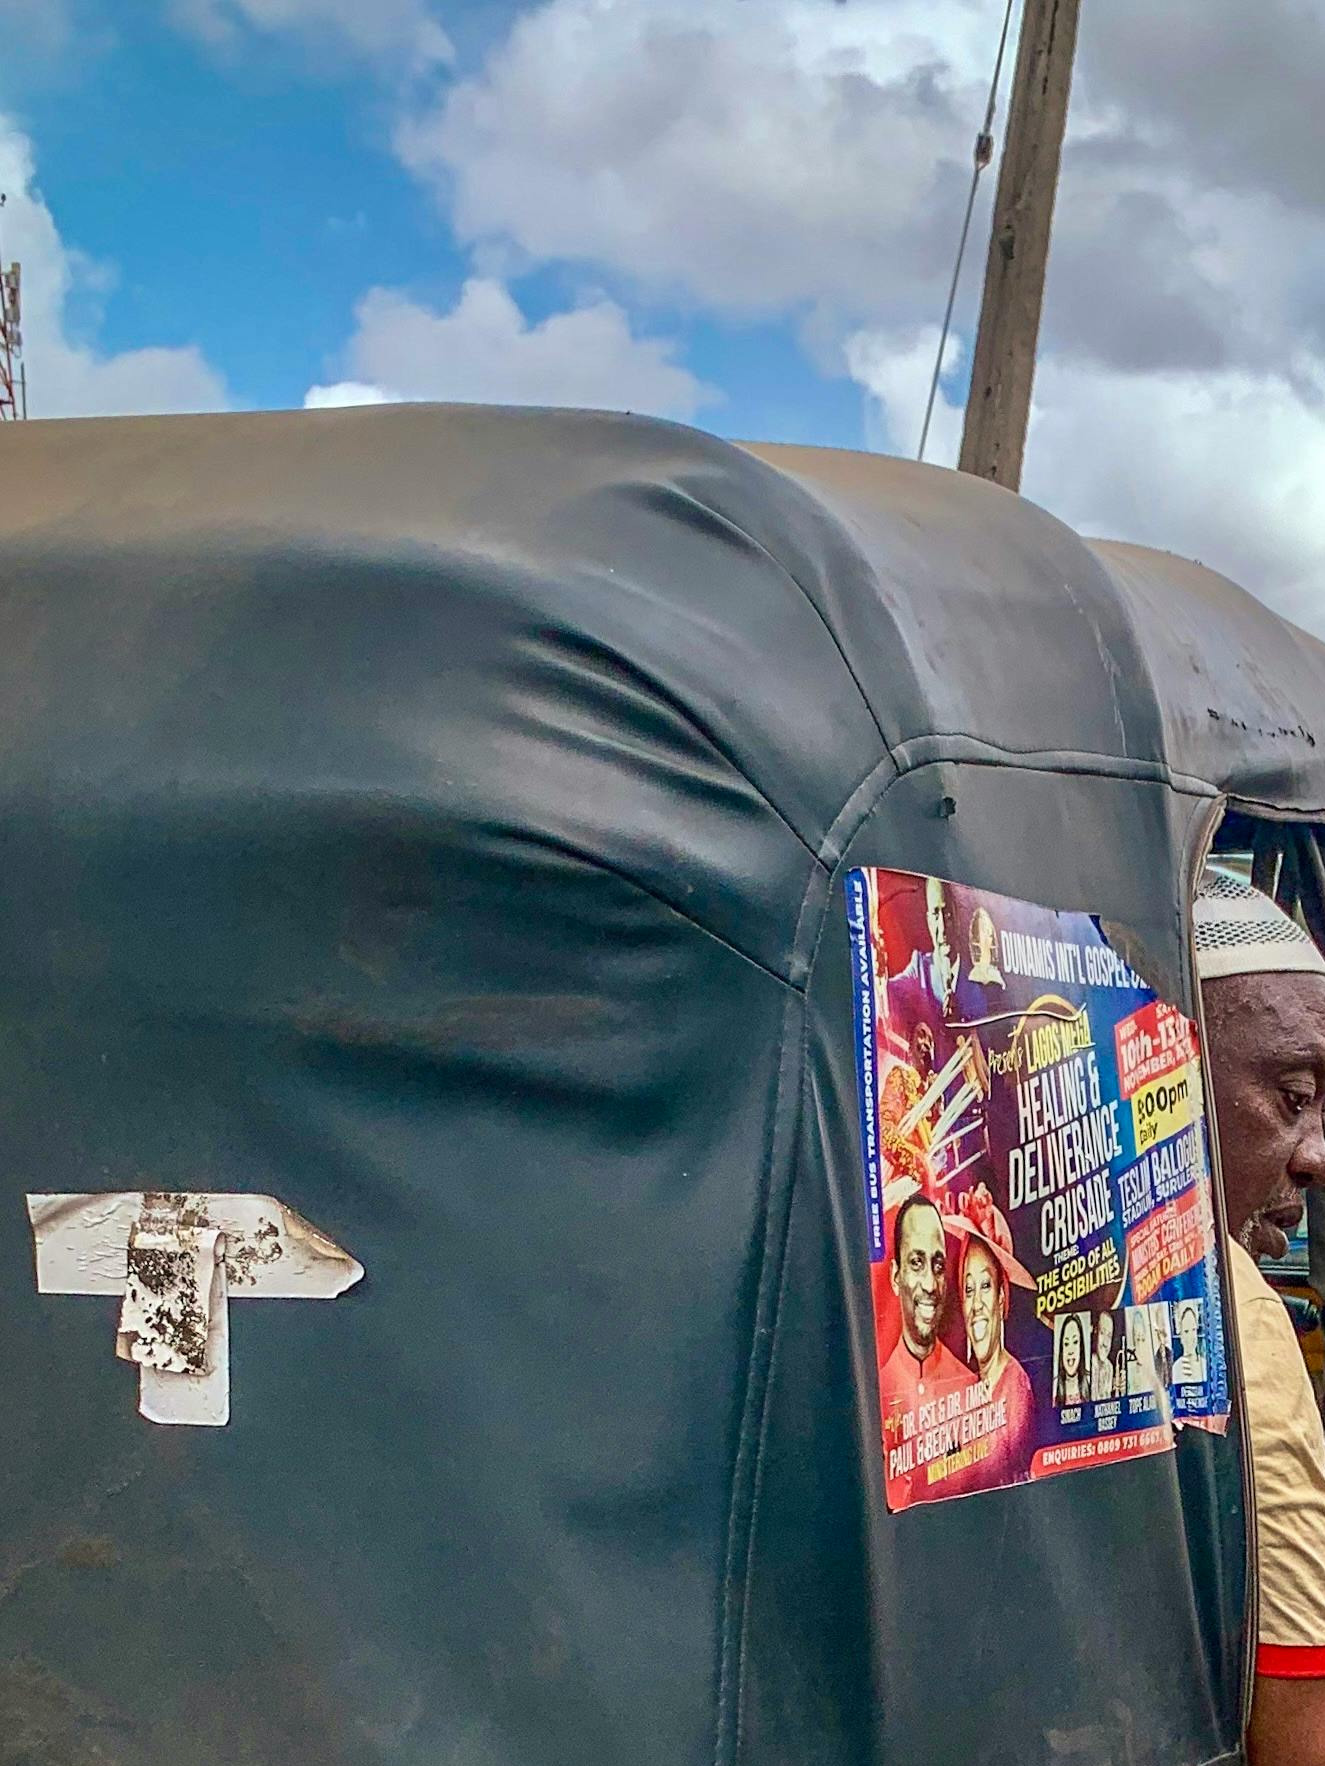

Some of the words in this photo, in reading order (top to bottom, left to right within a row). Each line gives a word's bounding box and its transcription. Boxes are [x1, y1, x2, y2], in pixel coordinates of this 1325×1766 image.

[853, 880, 871, 987] AVAILABLE
[1001, 931, 1056, 980] DUNAMIS
[1055, 942, 1087, 985] INT'L
[1086, 944, 1129, 988] GOSPEL
[862, 990, 876, 1158] TRANSPORTATION
[1024, 1022, 1063, 1074] LAGOS
[1017, 1057, 1088, 1145] HEALING
[1087, 1051, 1102, 1109] &
[868, 1161, 878, 1199] BUS
[1008, 1099, 1123, 1211] DELIVERANCE
[1151, 1129, 1197, 1187] BALOGU
[871, 1203, 882, 1249] FREE
[1041, 1168, 1115, 1257] CRUSADE
[1036, 1267, 1061, 1294] THE
[1061, 1256, 1086, 1278] GOD
[1087, 1246, 1101, 1268] OF
[1101, 1237, 1117, 1261] ALL
[1053, 1244, 1080, 1265] THEME:
[1163, 1242, 1197, 1277] DAILY
[1036, 1254, 1121, 1319] POSSIBILITIES
[889, 1441, 916, 1481] PAUL
[924, 1421, 961, 1462] BECKY
[962, 1397, 1008, 1446] ENENCHE
[1042, 1443, 1096, 1466] ENQUIRIES:
[1097, 1439, 1121, 1454] 0809
